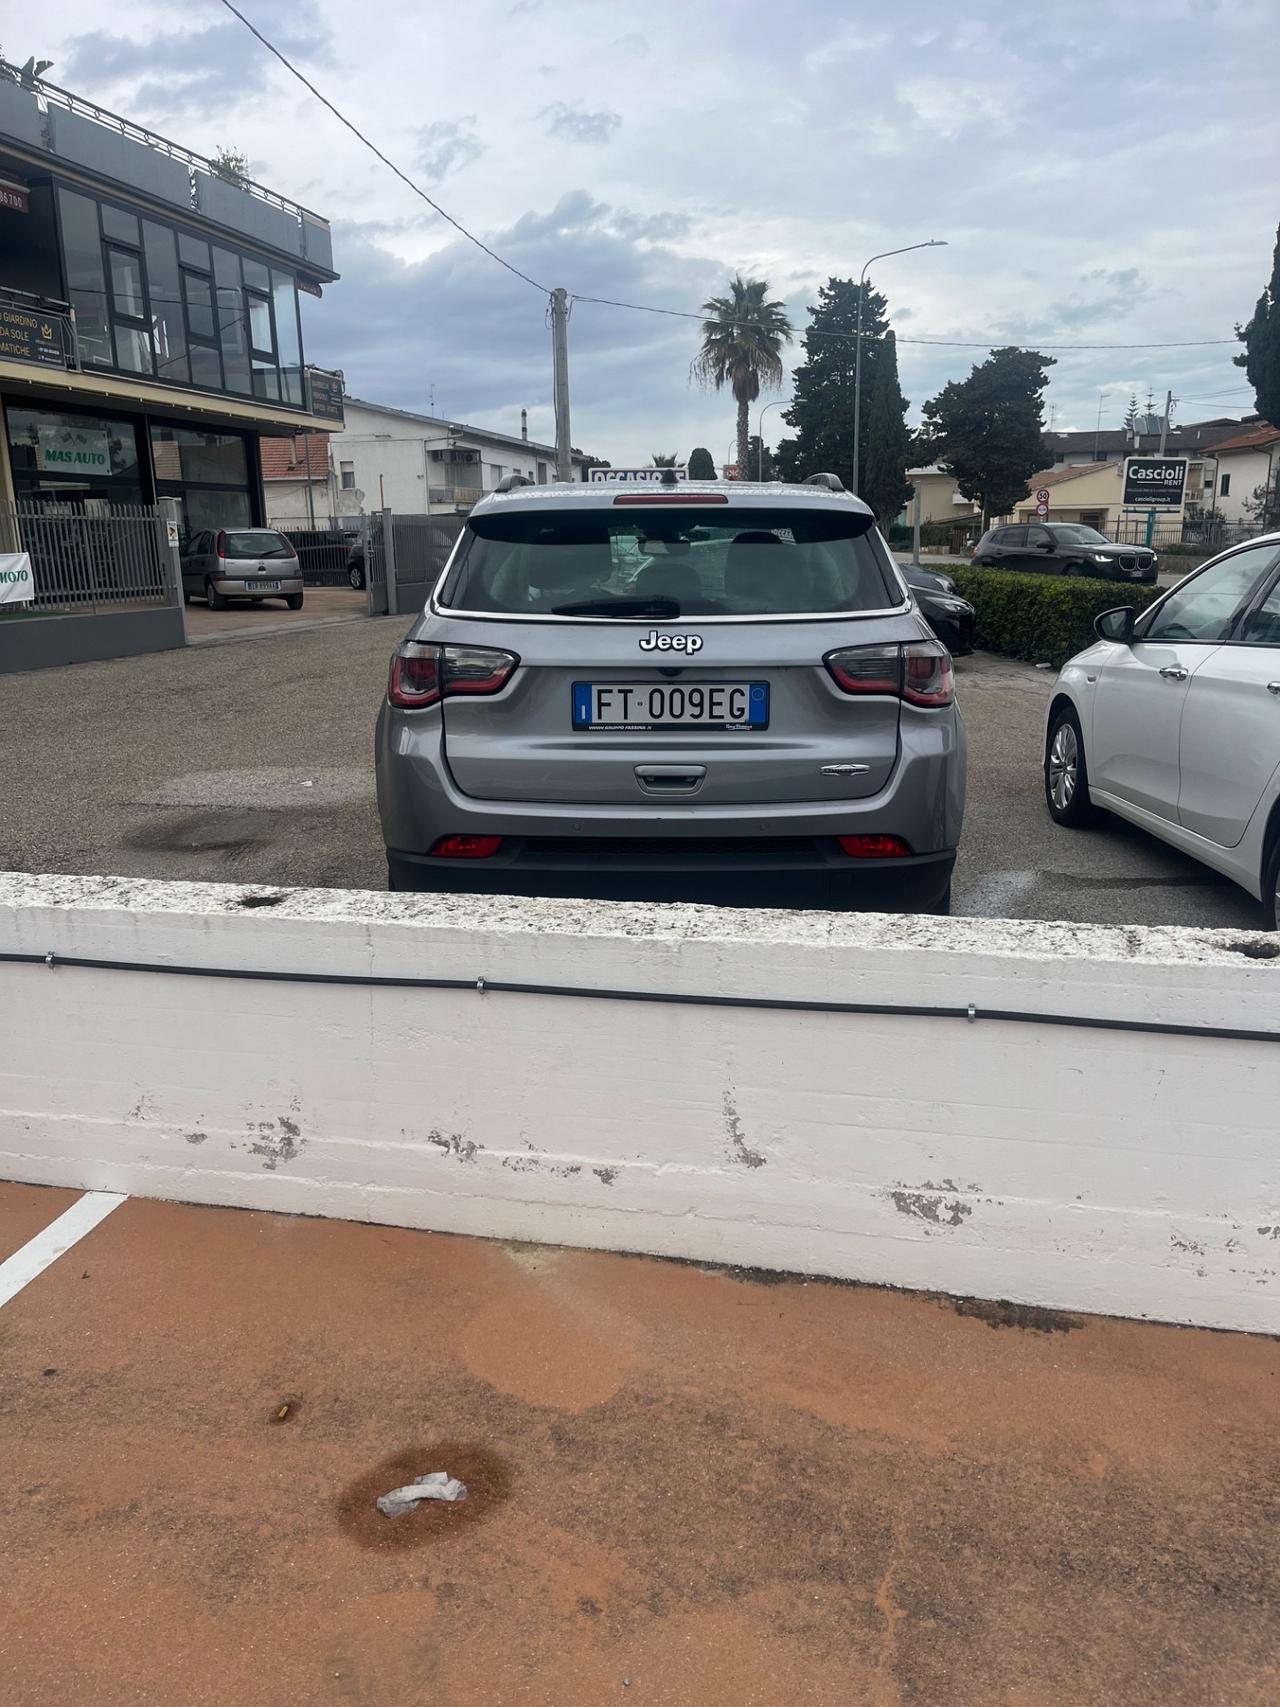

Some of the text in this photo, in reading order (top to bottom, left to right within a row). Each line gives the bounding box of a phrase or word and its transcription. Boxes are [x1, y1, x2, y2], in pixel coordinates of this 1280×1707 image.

[3, 312, 38, 329] GIARDINO
[11, 328, 30, 342] SOLE
[46, 449, 105, 465] MAS AUTO
[1128, 465, 1184, 480] Cascioli
[1039, 492, 1048, 500] 50
[639, 629, 703, 656] Jeep
[596, 686, 746, 720] FT 009EG
